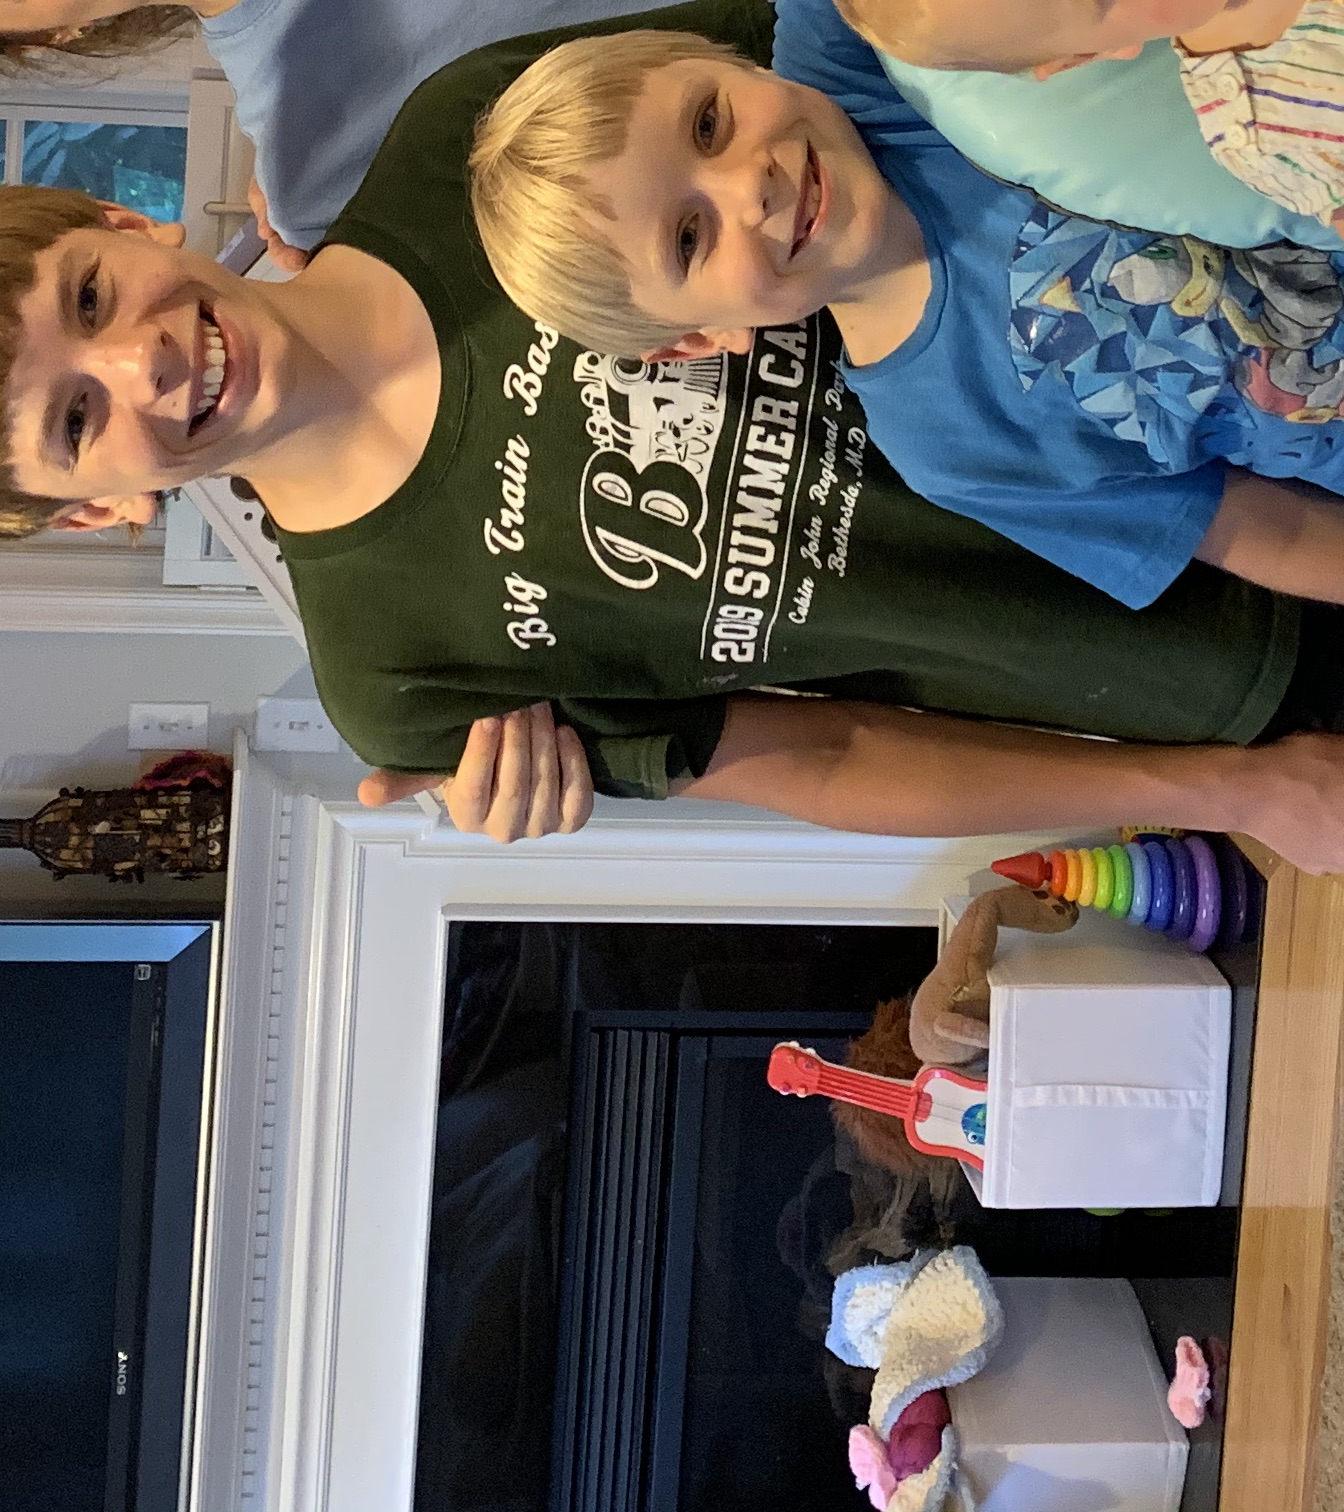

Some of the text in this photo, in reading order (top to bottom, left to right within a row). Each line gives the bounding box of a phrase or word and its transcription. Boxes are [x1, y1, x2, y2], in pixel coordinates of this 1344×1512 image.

[483, 320, 560, 650] Big Train Bas
[710, 316, 808, 663] 2019 SUMMER CA
[808, 416, 840, 506] Regional
[826, 427, 867, 577] Bethesda, MD
[799, 515, 824, 570] John
[788, 577, 816, 625] Cabin
[116, 1351, 128, 1396] SONY
